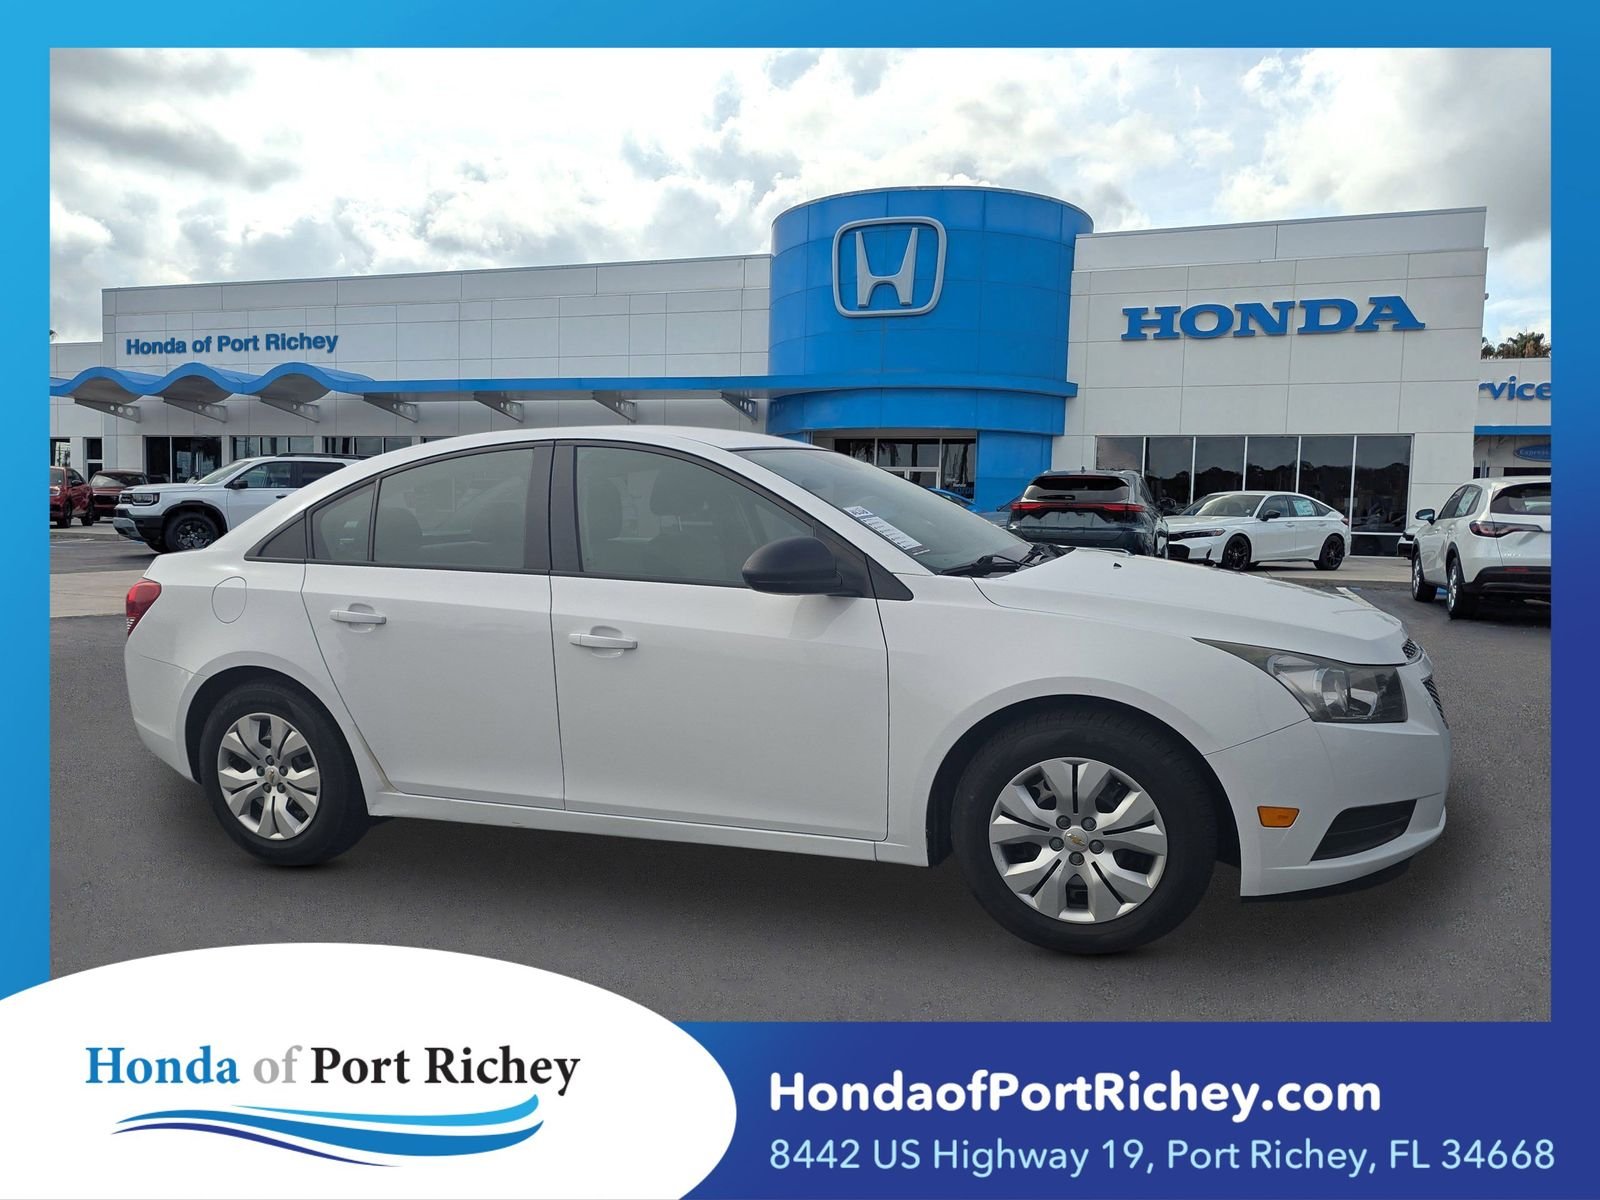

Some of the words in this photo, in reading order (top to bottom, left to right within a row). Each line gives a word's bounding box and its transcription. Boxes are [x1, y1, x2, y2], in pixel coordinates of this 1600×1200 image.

[1121, 295, 1426, 341] HONDA
[126, 337, 187, 355] Honda
[192, 335, 212, 353] of
[217, 335, 260, 353] Port
[265, 332, 339, 354] Richey
